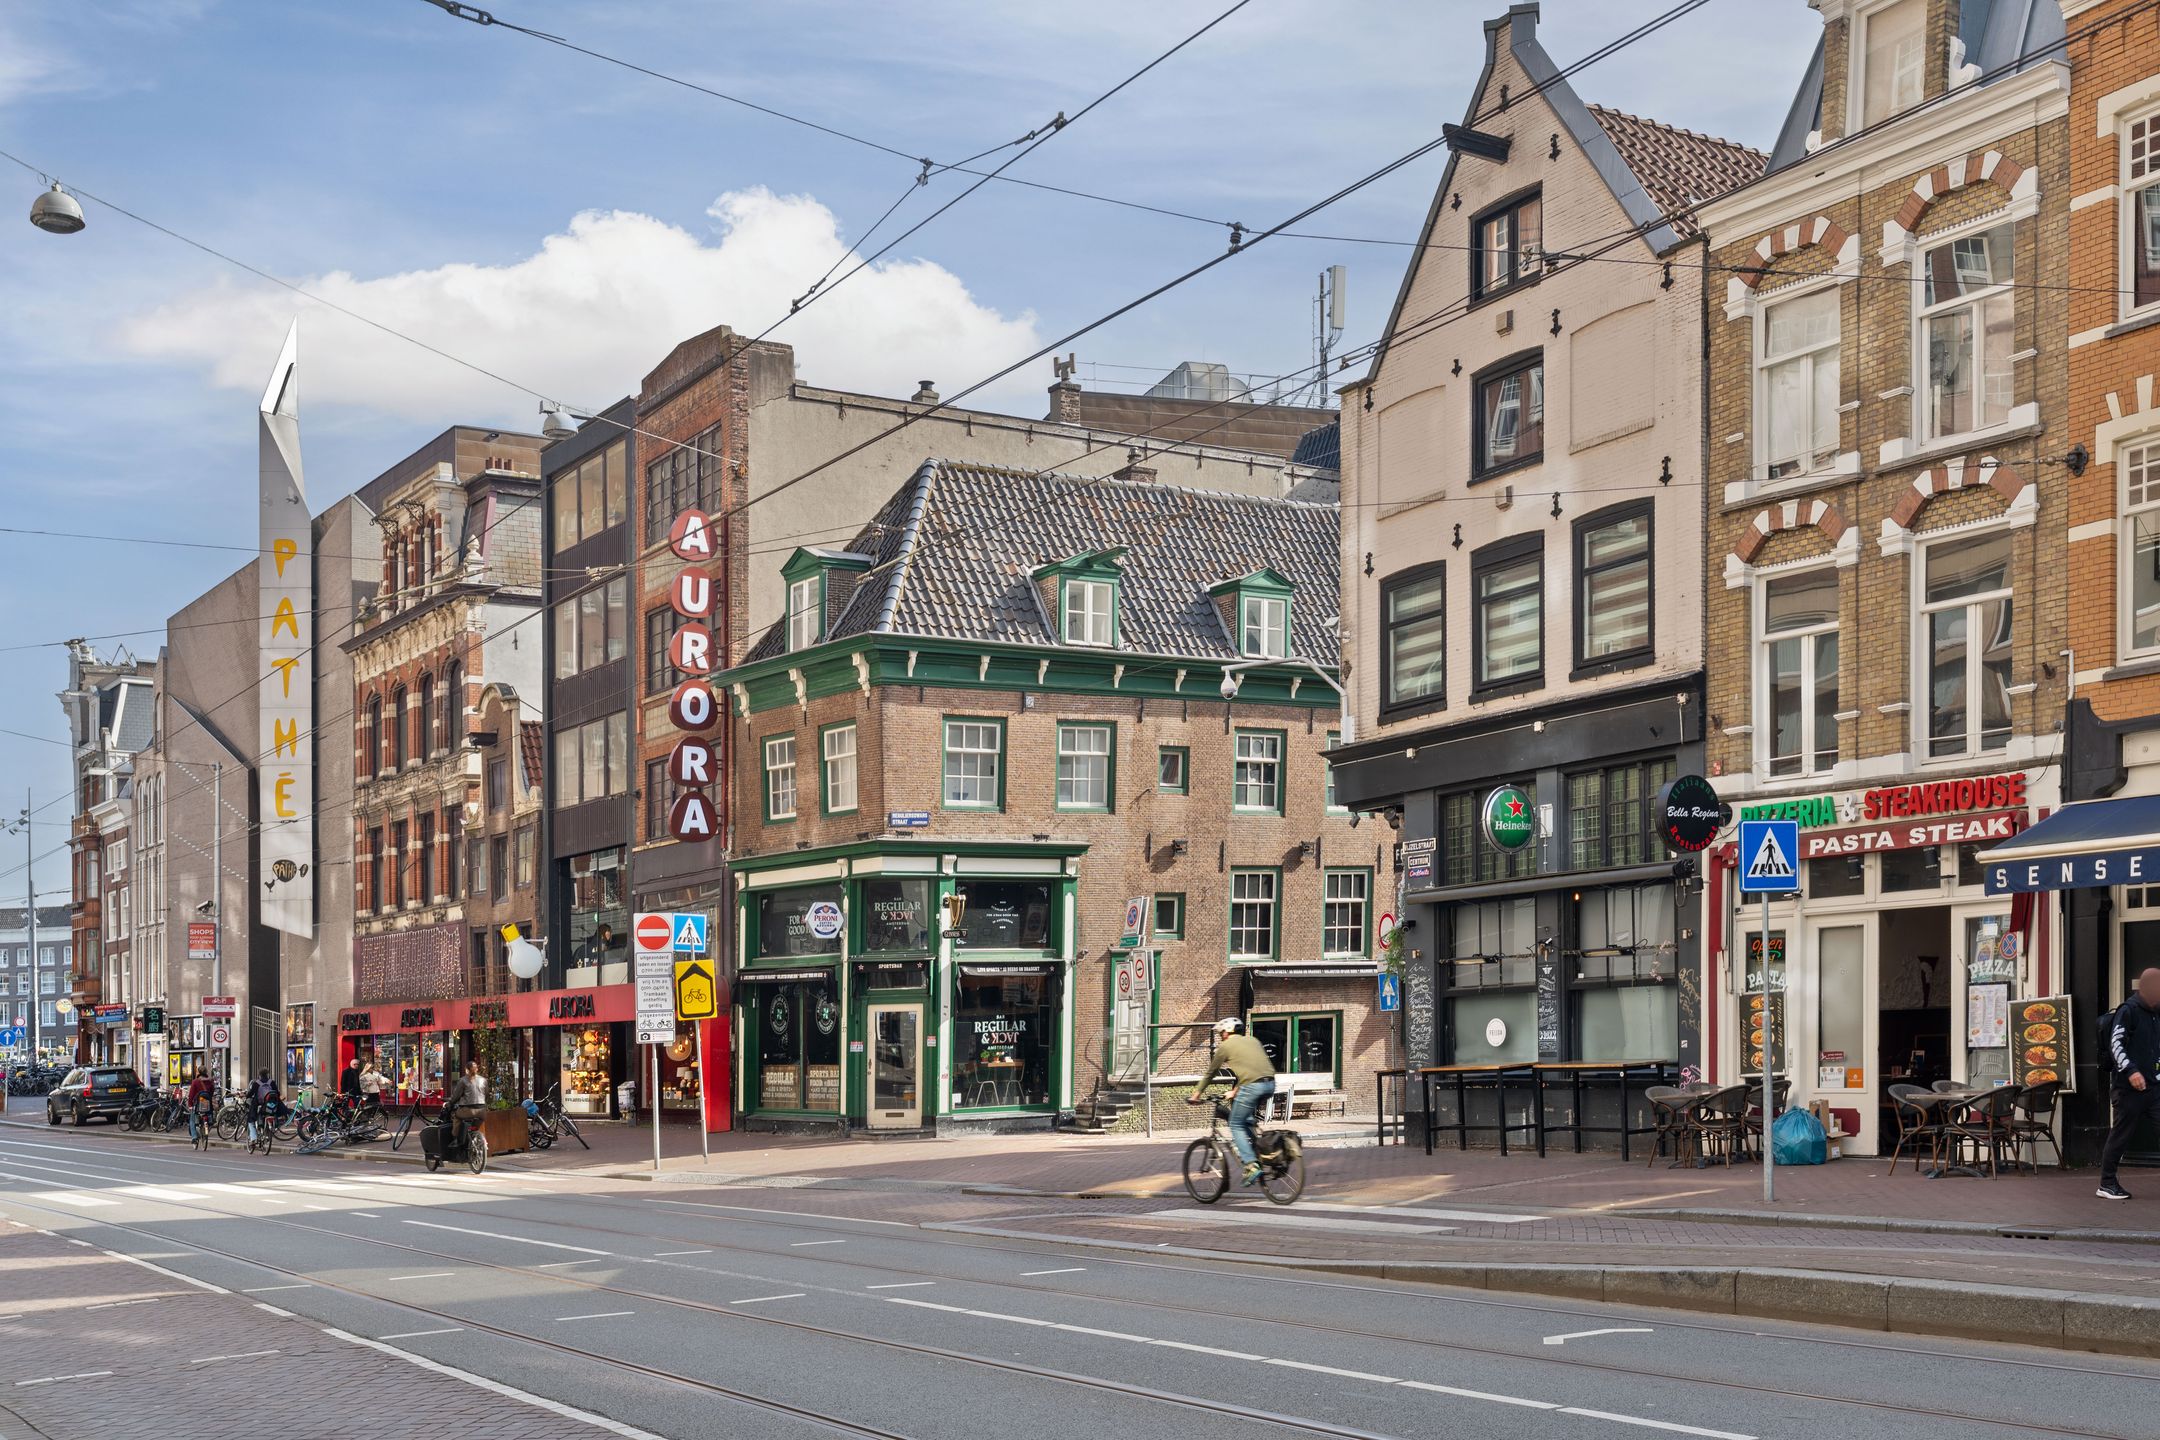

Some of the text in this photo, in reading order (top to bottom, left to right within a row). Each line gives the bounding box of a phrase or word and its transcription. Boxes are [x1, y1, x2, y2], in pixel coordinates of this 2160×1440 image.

[271, 538, 300, 817] PATHÉ
[680, 516, 711, 835] AURORA
[1840, 793, 1860, 822] &
[1864, 772, 2027, 820] STEAKHOUSE
[1667, 806, 1719, 820] Bella Regina
[1495, 821, 1532, 831] Heineken
[1670, 825, 1718, 851] Restaurant
[1809, 817, 2012, 855] PASTA STEAK
[1996, 855, 2143, 888] SENSE
[874, 902, 921, 911] REGULAR
[790, 915, 800, 925] FOR
[881, 911, 888, 920] &
[789, 926, 805, 935] GOOD
[1968, 959, 2015, 979] PIZZA
[1747, 968, 1788, 989] PATA
[549, 994, 596, 1019] AURORA
[974, 1020, 1027, 1033] REGULAR
[981, 1033, 990, 1044] &
[766, 1072, 794, 1081] REGULAR
